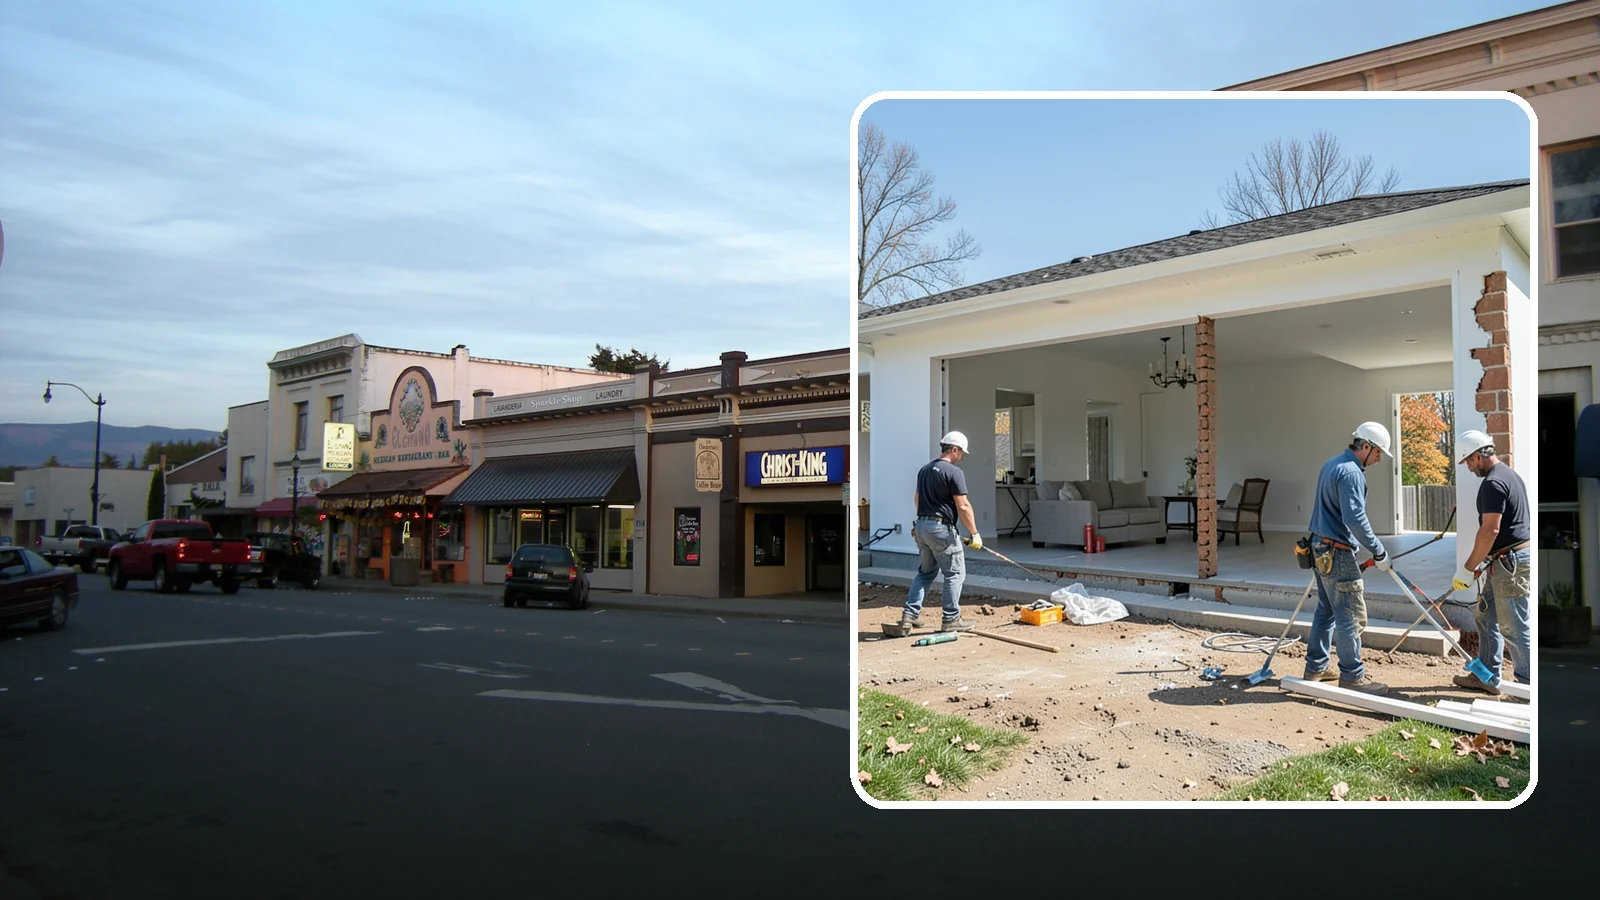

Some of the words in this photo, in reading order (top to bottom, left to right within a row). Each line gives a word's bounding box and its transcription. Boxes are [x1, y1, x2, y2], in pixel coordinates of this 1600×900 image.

[596, 389, 624, 399] LAUNDRY
[493, 402, 523, 412] LAVANDERIA
[531, 396, 560, 409] Sparkle
[562, 394, 582, 404] Shop
[374, 454, 396, 464] MEXICAN
[397, 451, 433, 462] RESTAURANT
[438, 450, 450, 459] BAR
[761, 452, 797, 478] CHRIST
[799, 450, 827, 476] KING
